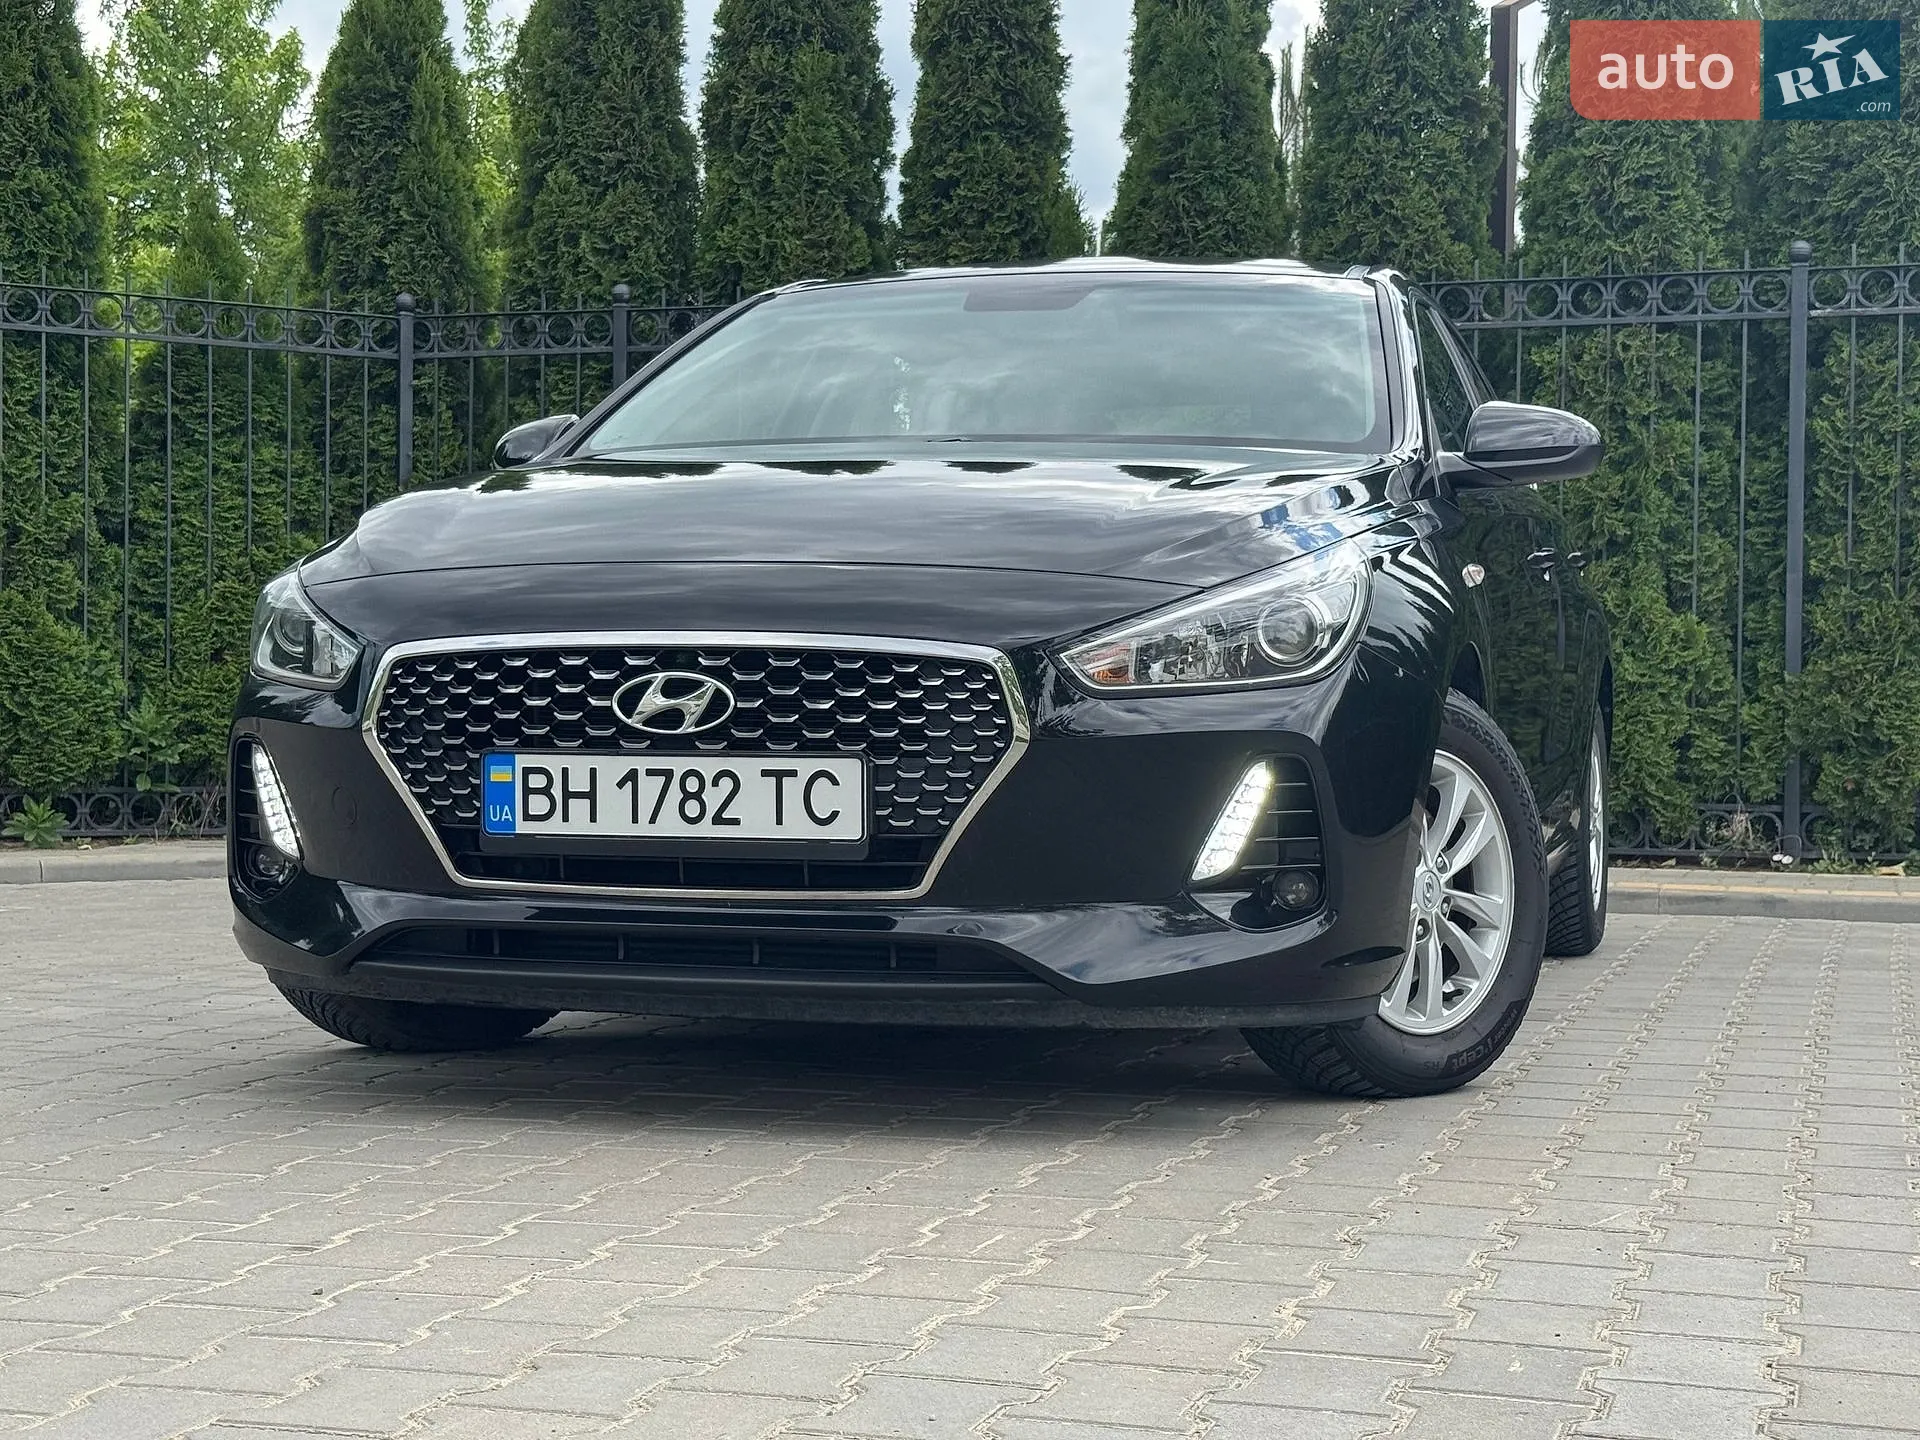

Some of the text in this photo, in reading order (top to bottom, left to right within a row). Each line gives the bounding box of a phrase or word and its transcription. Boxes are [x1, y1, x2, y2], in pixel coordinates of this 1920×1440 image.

[490, 804, 513, 821] UA
[522, 767, 840, 826] BH 1782 TC
